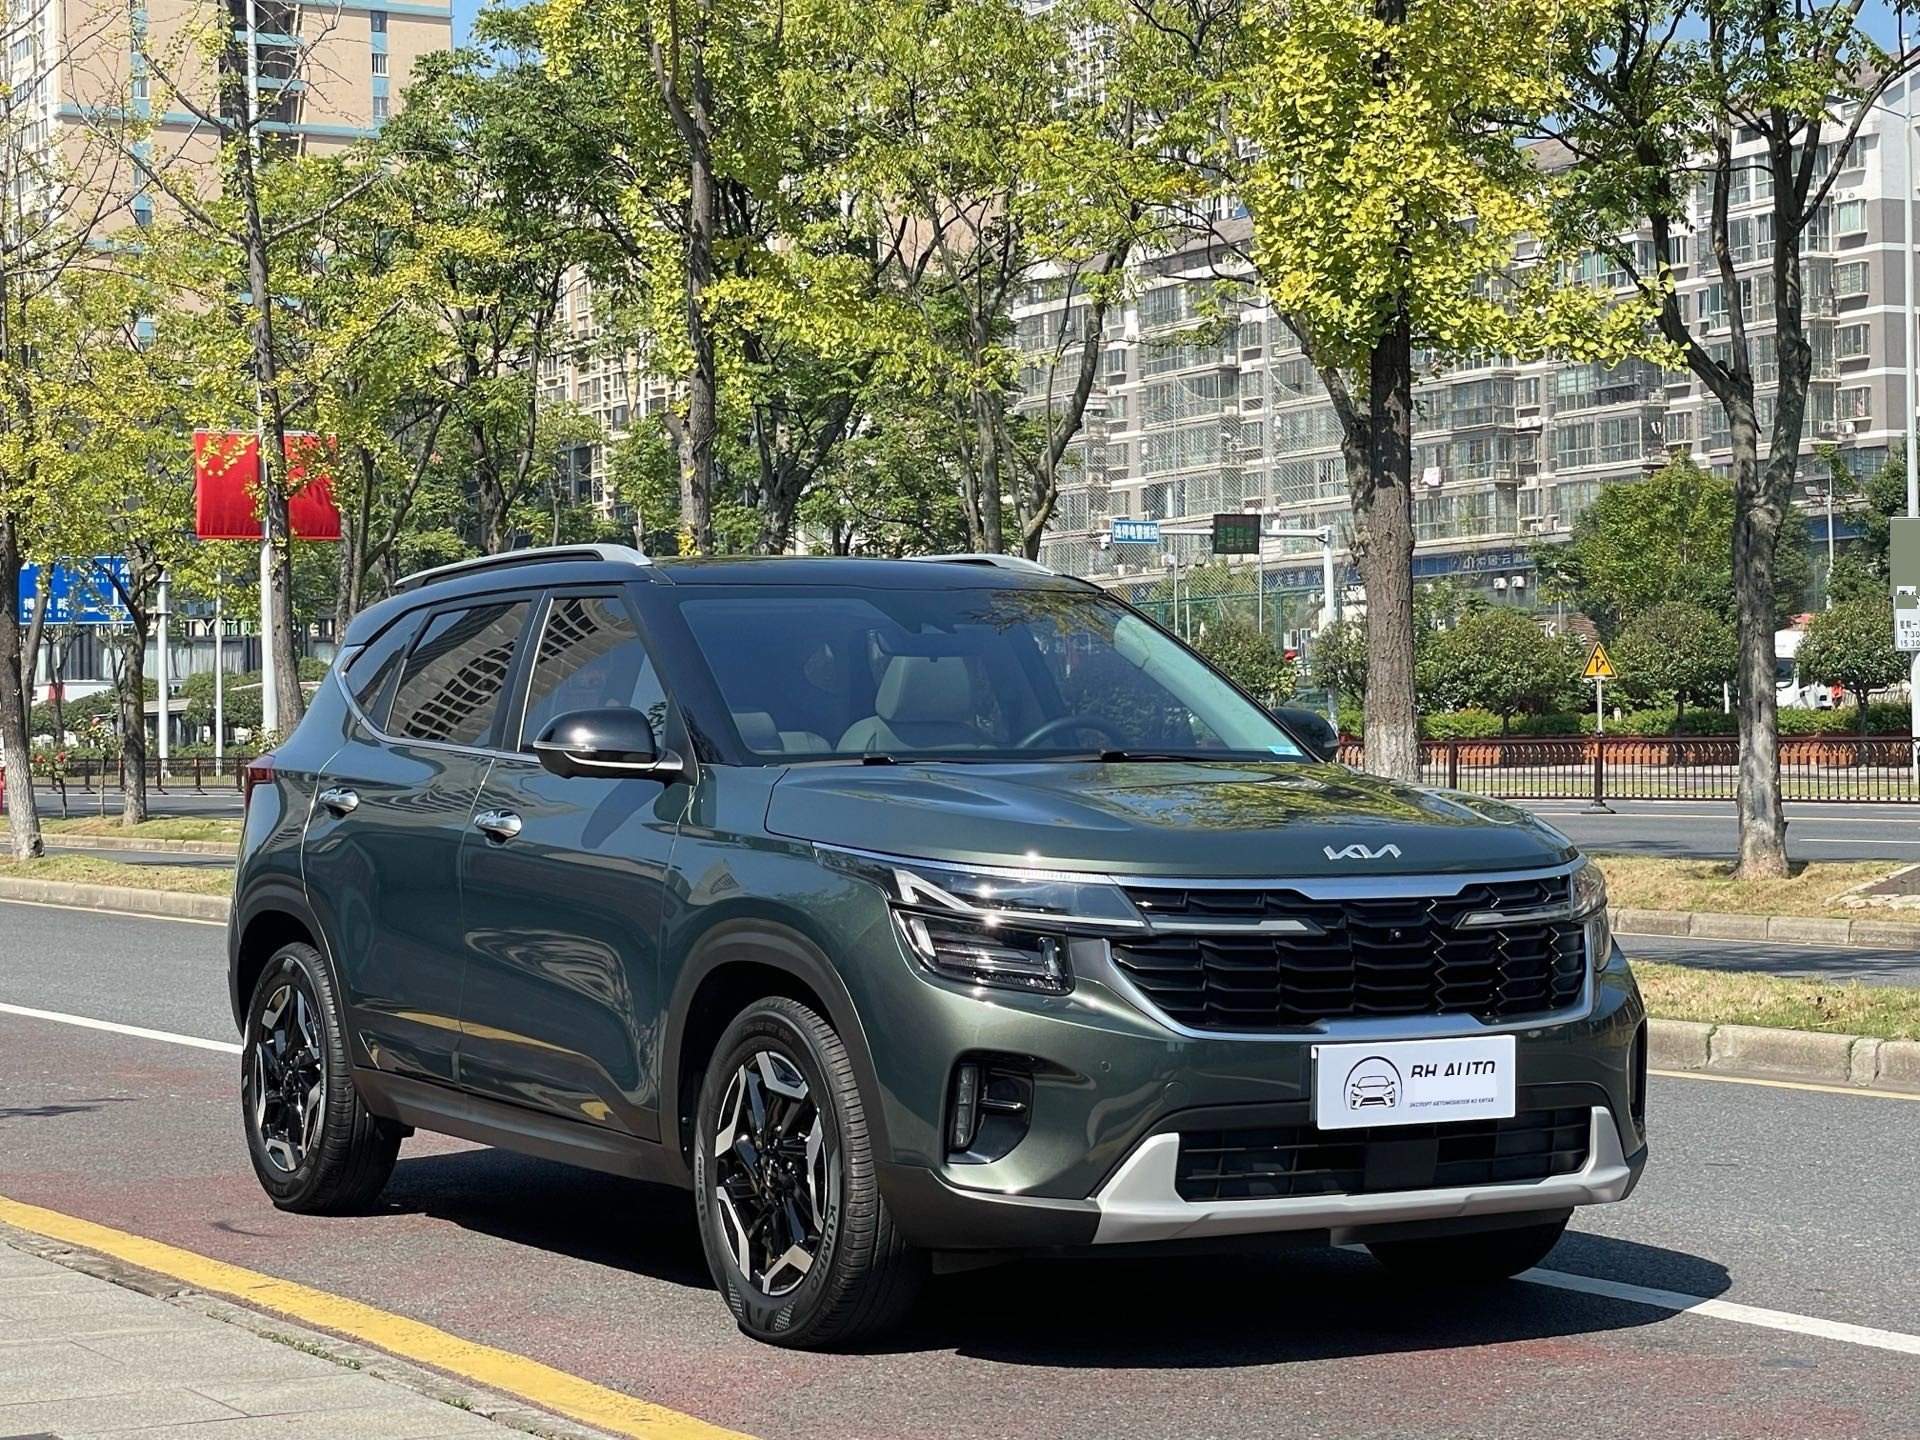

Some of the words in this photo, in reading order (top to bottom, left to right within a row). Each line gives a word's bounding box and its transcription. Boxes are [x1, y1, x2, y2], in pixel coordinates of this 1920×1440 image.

[1114, 524, 1157, 539] 违停电警抓拍
[1322, 844, 1402, 860] KIA
[809, 1204, 837, 1292] KUMHO
